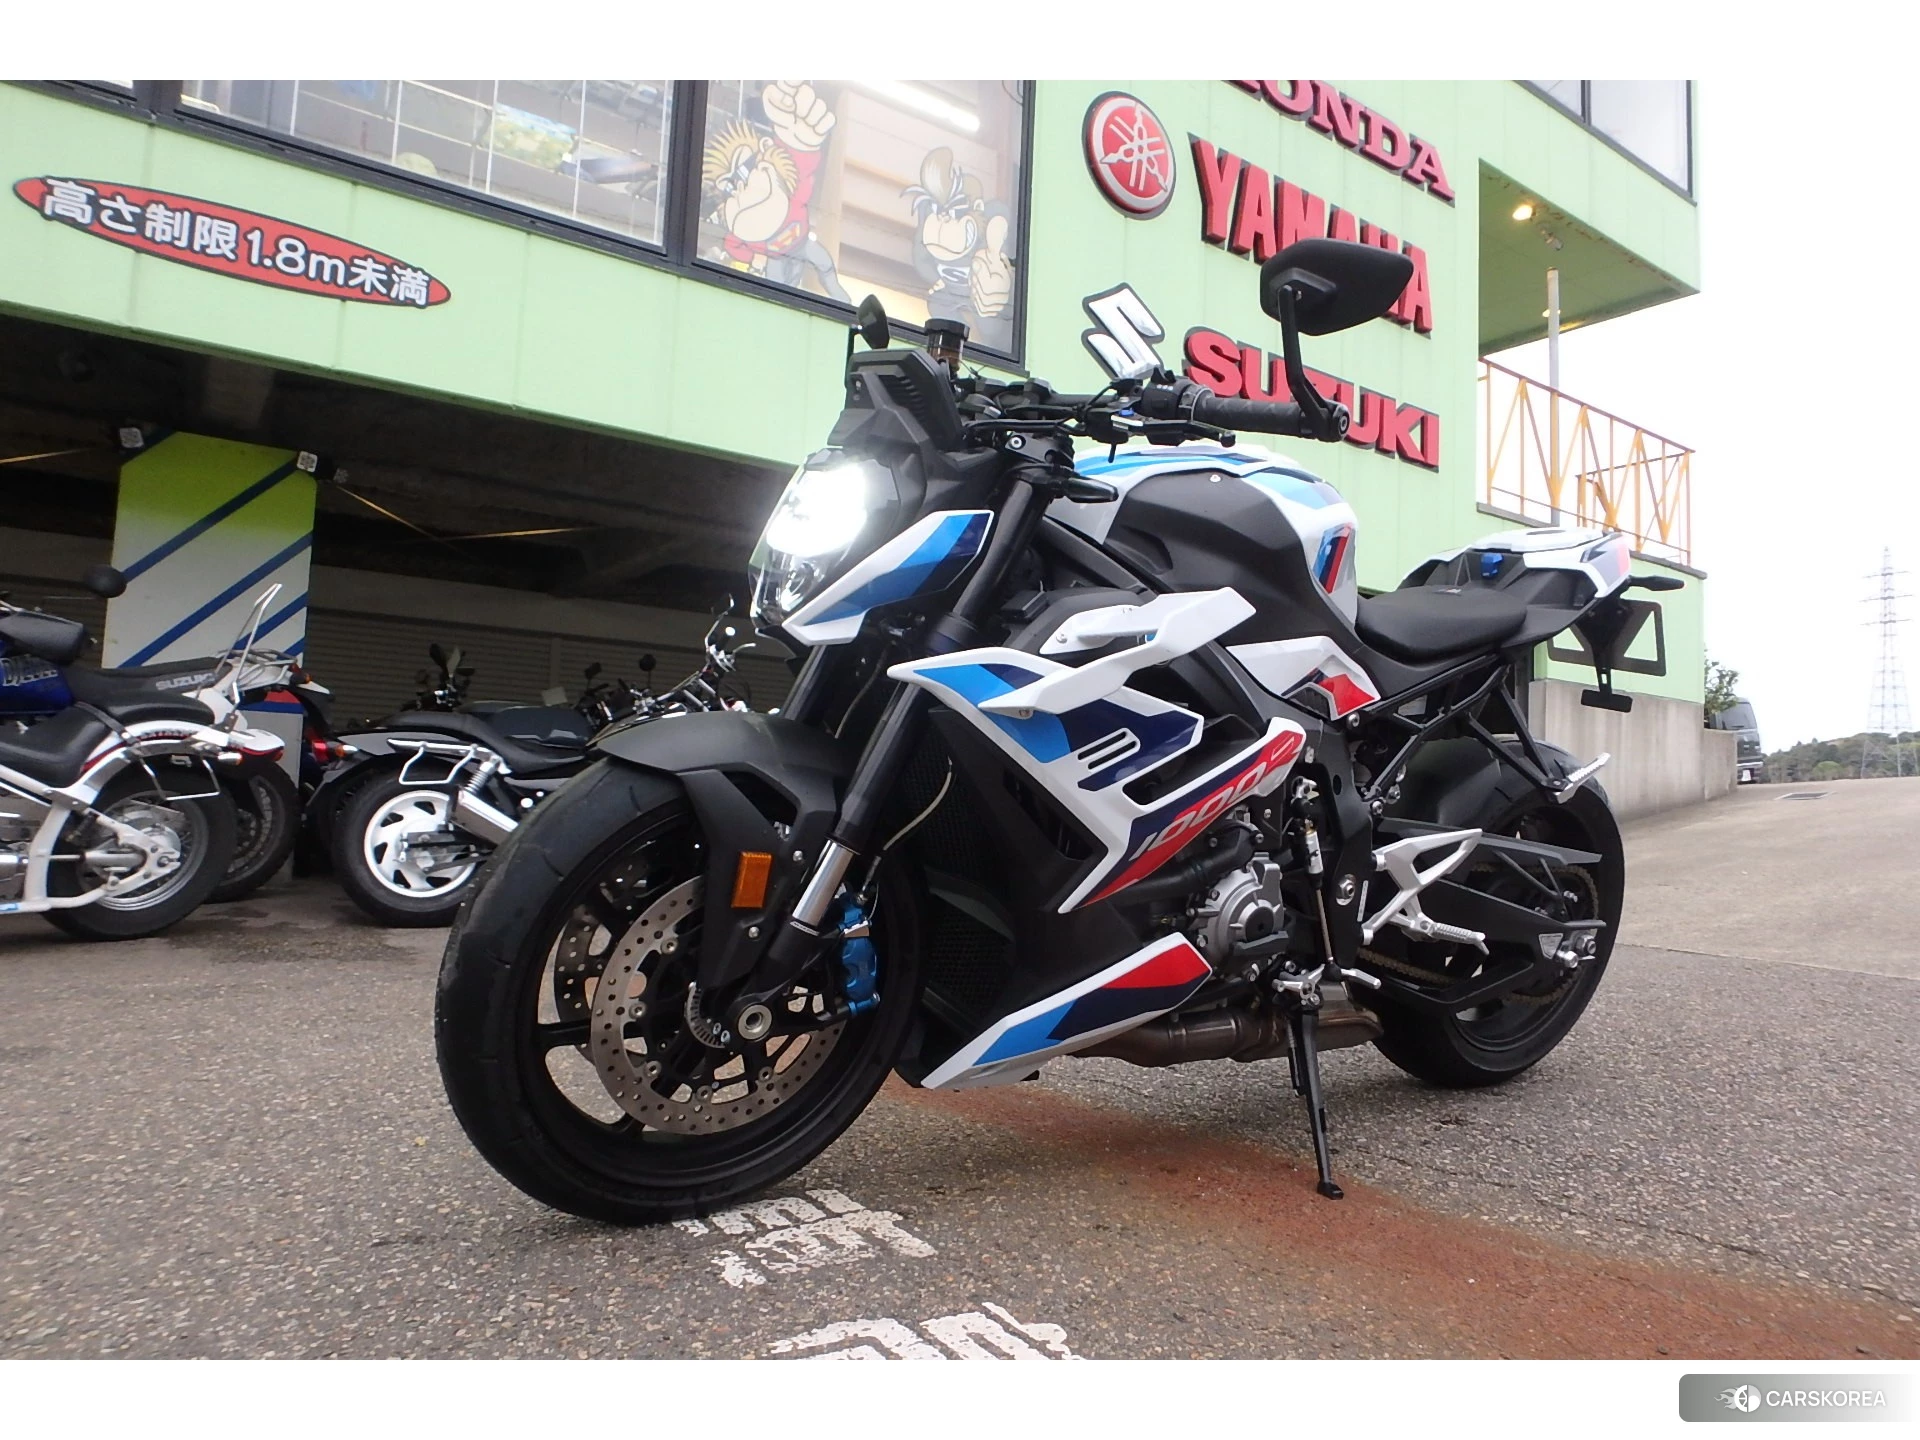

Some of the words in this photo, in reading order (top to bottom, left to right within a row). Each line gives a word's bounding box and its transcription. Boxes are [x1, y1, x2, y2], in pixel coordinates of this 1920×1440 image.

[1218, 80, 1455, 204] ONDA
[43, 178, 431, 306] 高さ制限1.8m未満
